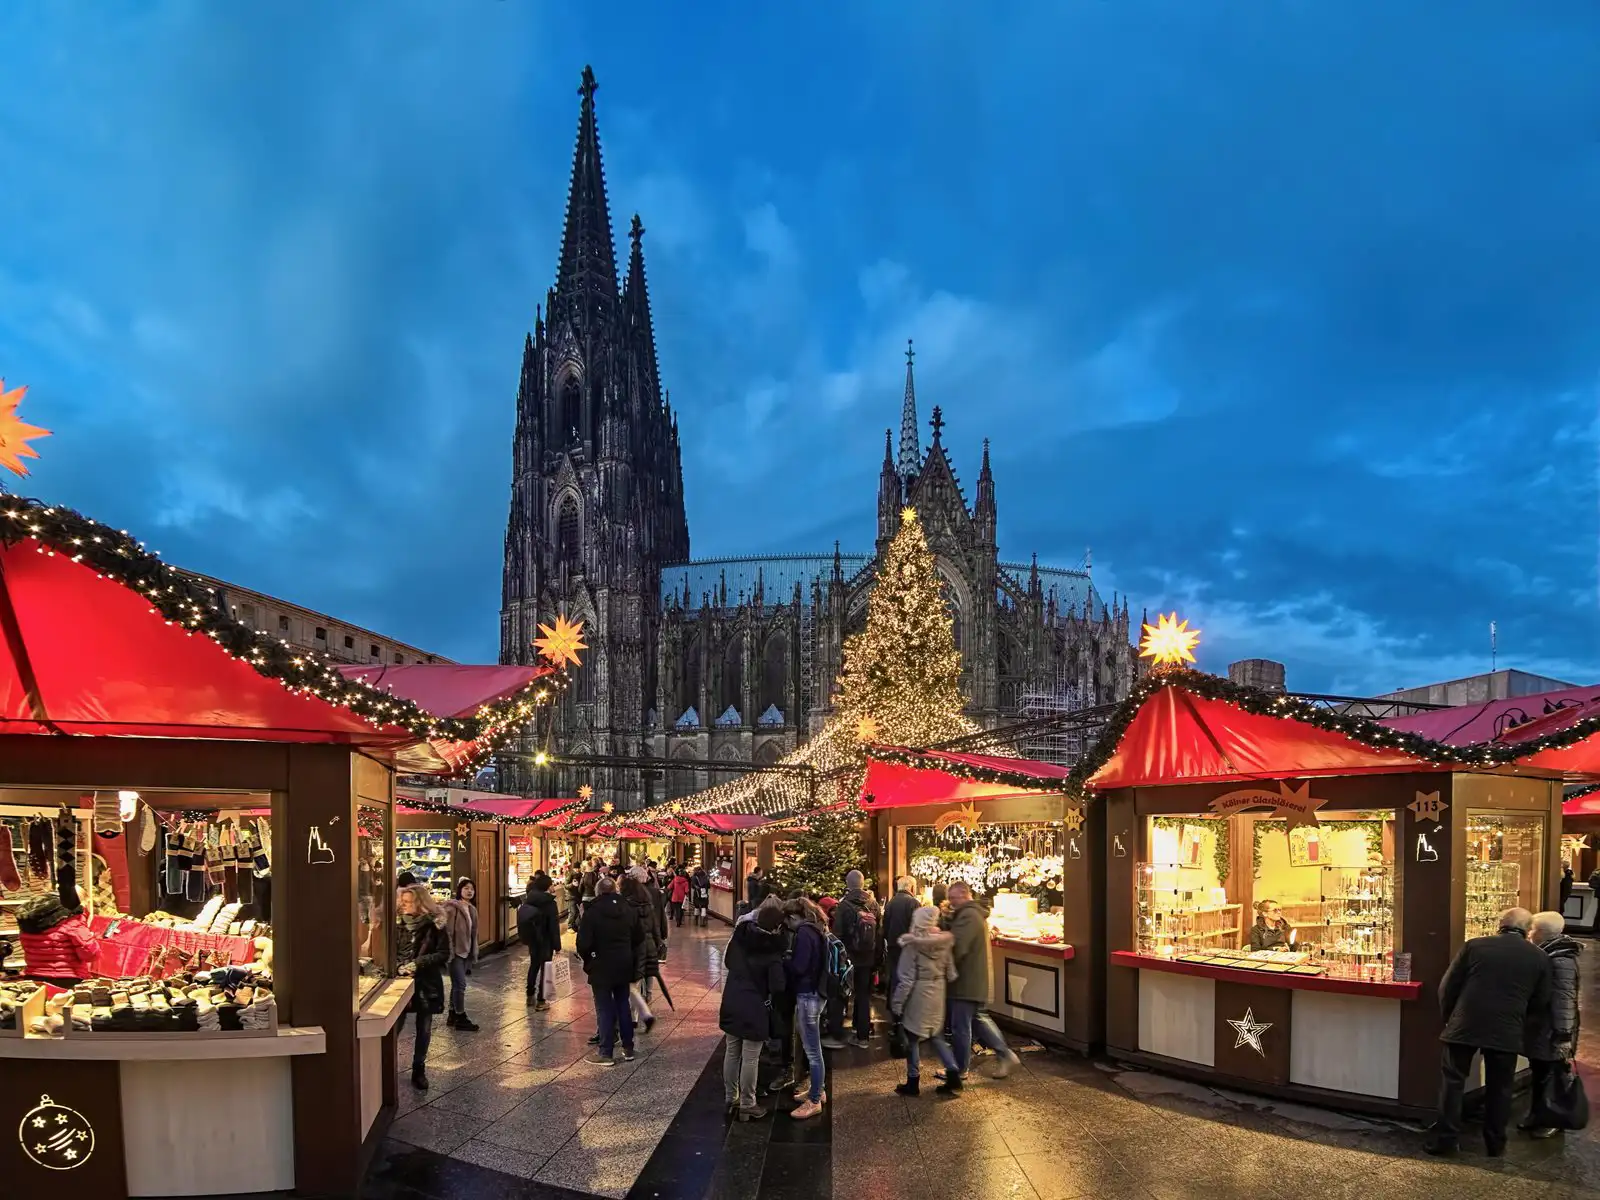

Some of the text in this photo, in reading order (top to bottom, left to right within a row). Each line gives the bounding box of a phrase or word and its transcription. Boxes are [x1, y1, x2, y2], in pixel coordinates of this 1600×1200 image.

[1221, 796, 1250, 809] Kölner
[1416, 800, 1438, 811] 113
[1068, 815, 1079, 823] 112
